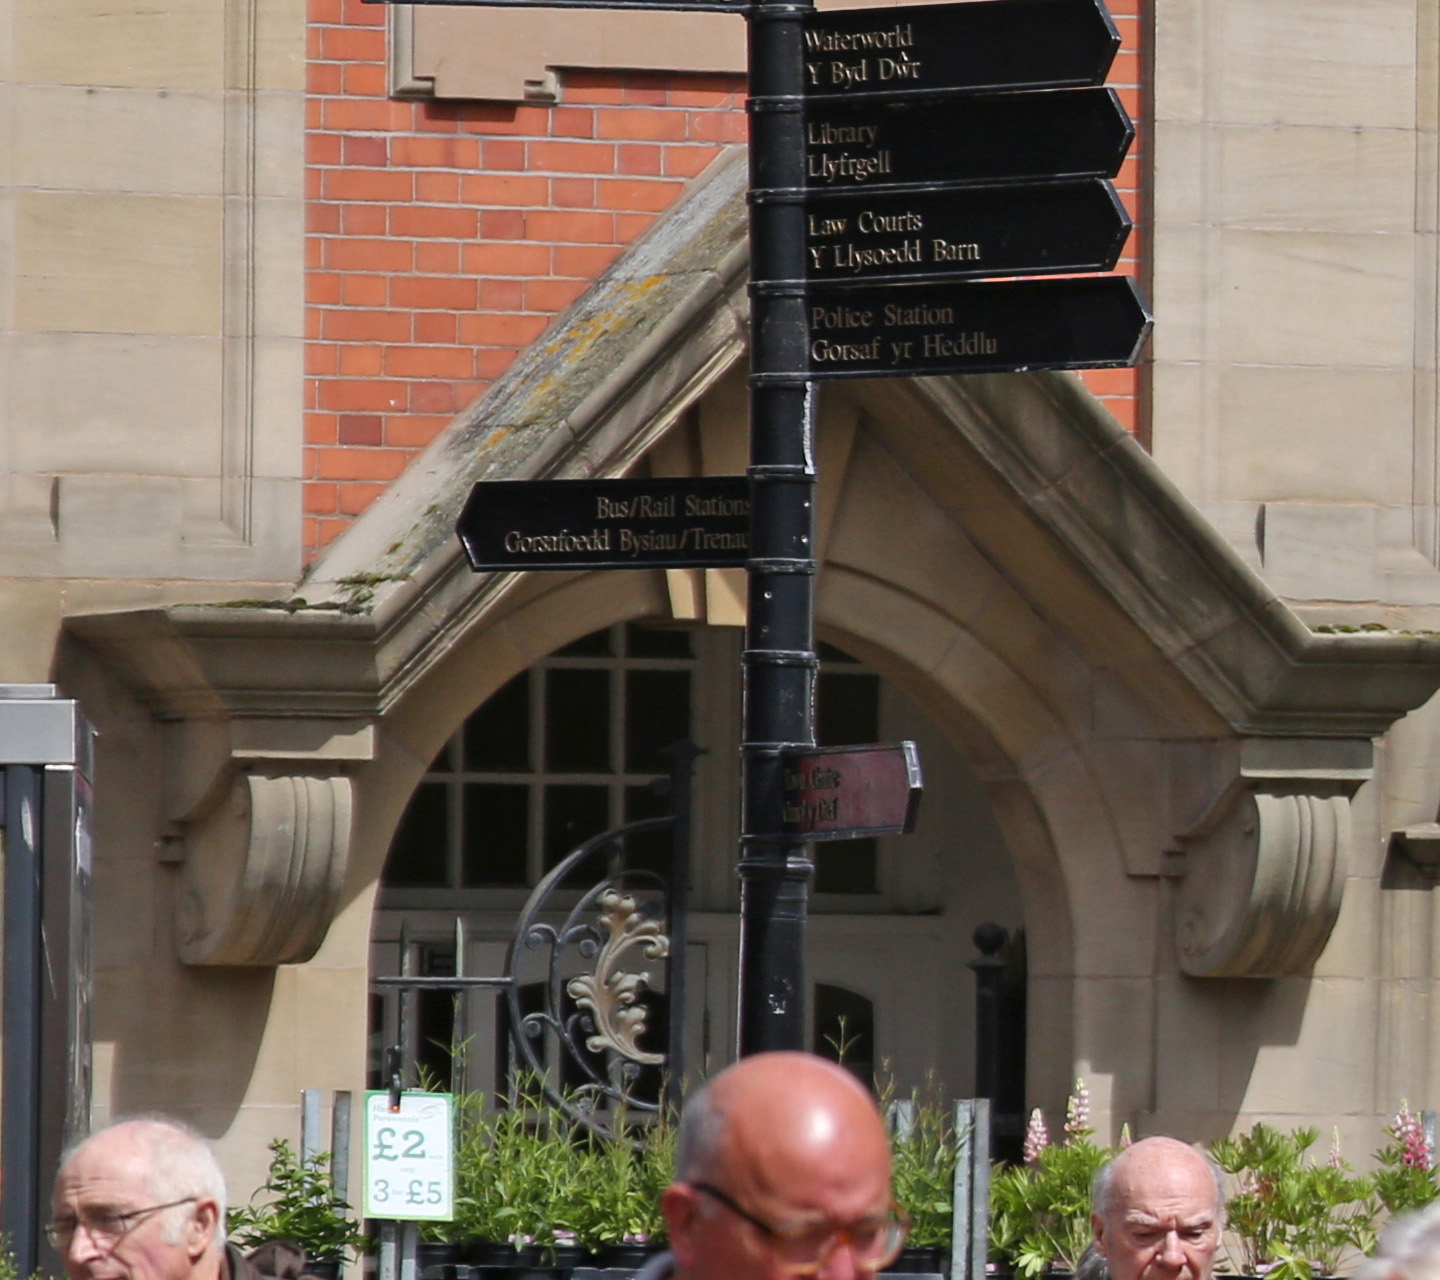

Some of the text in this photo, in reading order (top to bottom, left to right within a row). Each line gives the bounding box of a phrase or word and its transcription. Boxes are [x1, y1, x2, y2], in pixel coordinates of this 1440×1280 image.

[805, 24, 913, 52] Waterworld
[806, 62, 822, 86] Y
[832, 59, 868, 89] Byd
[807, 122, 878, 150] Library
[807, 151, 892, 182] Llyfrgell
[809, 210, 924, 237] Law Courts
[809, 239, 982, 274] Y Llysoedd Barn
[811, 302, 955, 331] Police Station
[811, 331, 998, 365] Gorsaf yr Heddlu
[596, 495, 676, 520] Bus/Rail
[504, 529, 611, 554] Gorsafoedd
[372, 1127, 426, 1161] £2
[373, 1179, 389, 1202] 3
[406, 1180, 442, 1204] £5
